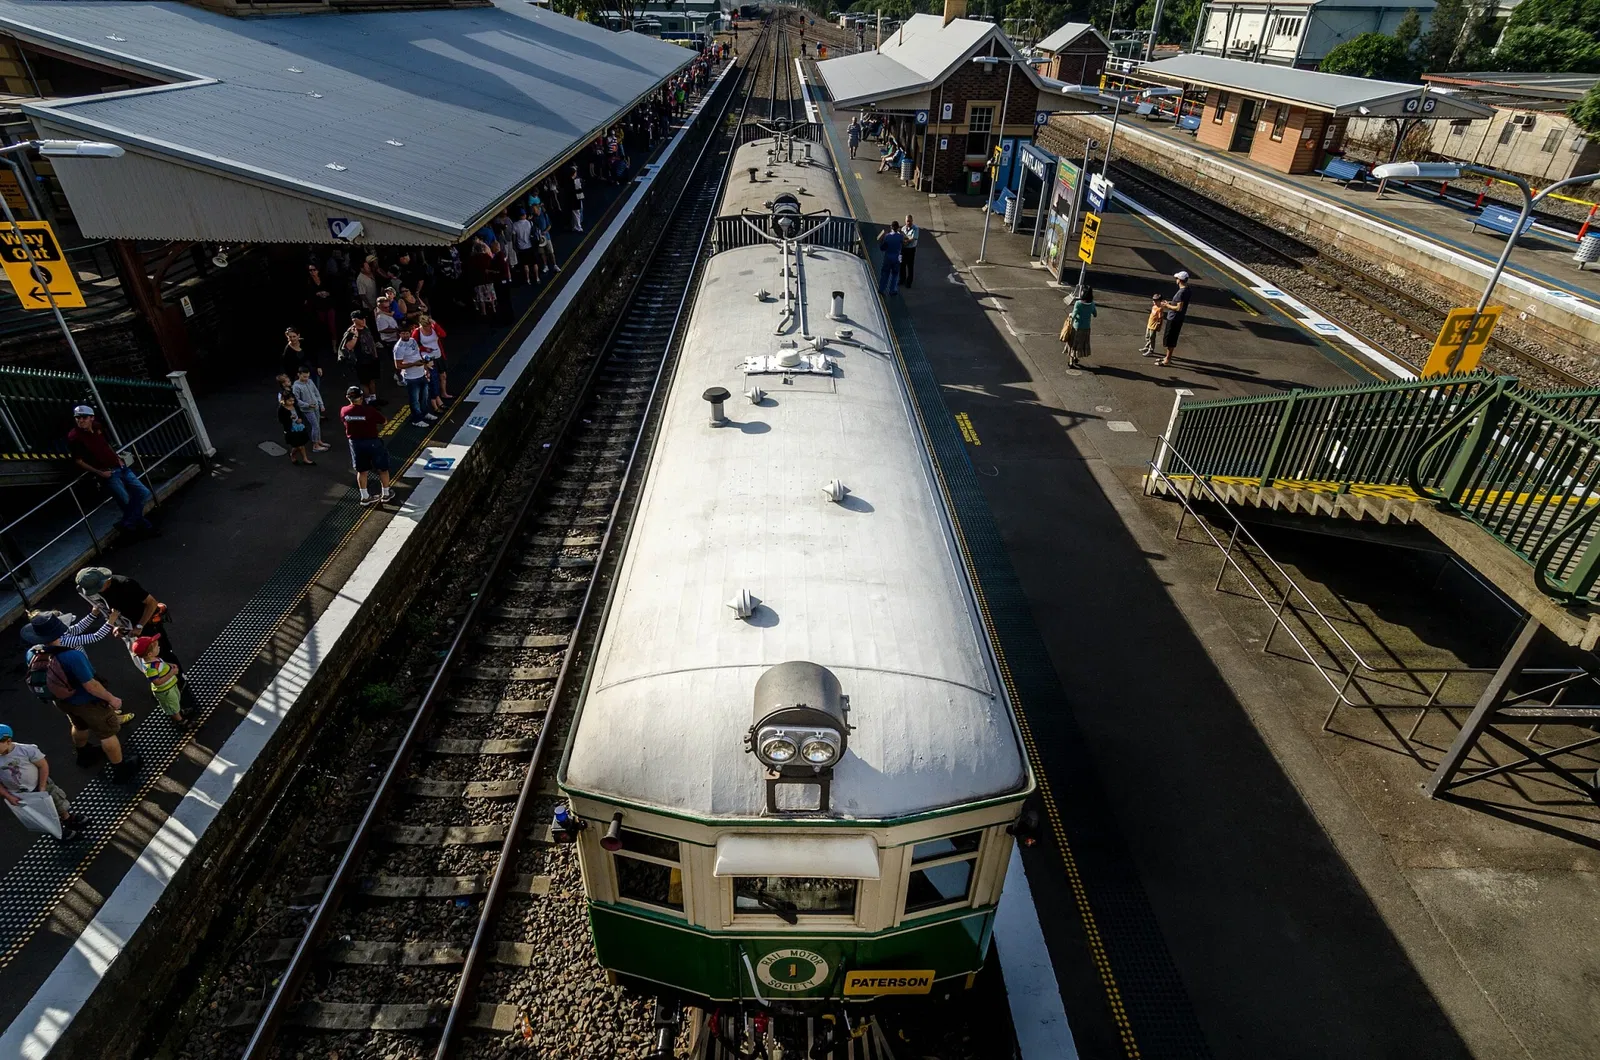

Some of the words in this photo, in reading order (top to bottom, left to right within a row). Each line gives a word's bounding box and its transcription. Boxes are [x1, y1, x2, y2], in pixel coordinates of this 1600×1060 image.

[1409, 101, 1416, 110] 4
[1425, 101, 1433, 110] 5
[919, 113, 926, 122] 2
[1039, 113, 1046, 122] 3
[1021, 148, 1044, 177] MAITLAND
[0, 233, 44, 247] Way
[12, 247, 51, 260] Out
[762, 953, 784, 966] RAIL
[790, 949, 824, 965] MOTOR
[768, 980, 815, 990] SOCIETY
[851, 977, 929, 988] PATERSON
